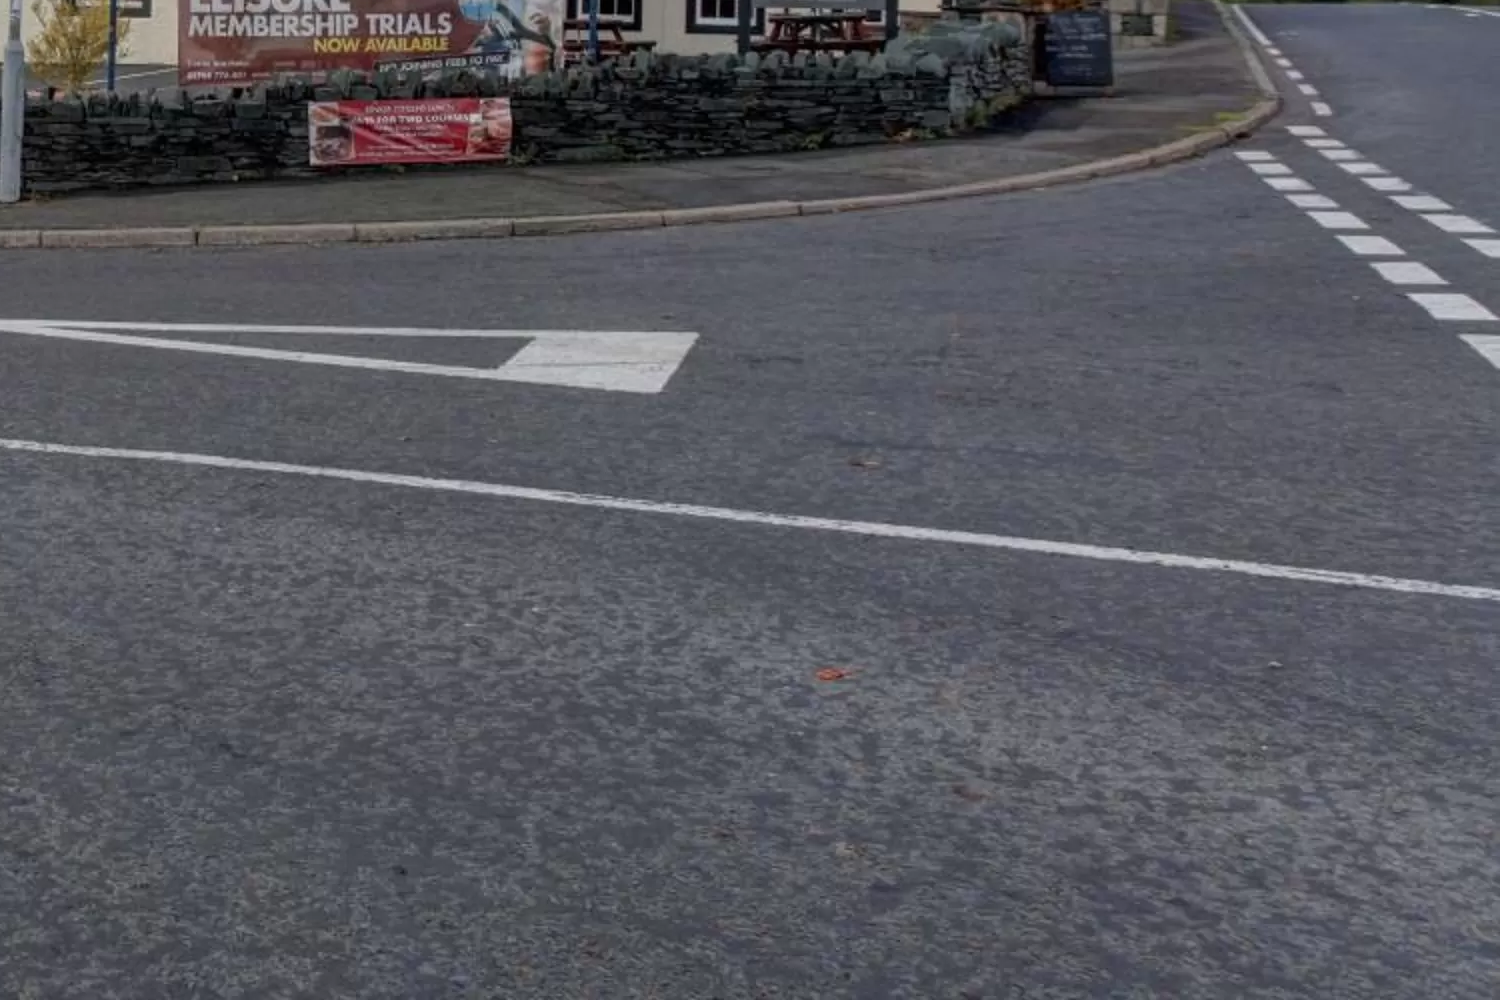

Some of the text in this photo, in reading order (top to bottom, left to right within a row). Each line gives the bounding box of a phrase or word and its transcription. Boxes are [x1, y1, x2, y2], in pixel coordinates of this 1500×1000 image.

[187, 12, 453, 38] MEMBERSHIP TRIALS
[313, 36, 450, 54] NOW AVAILABLE
